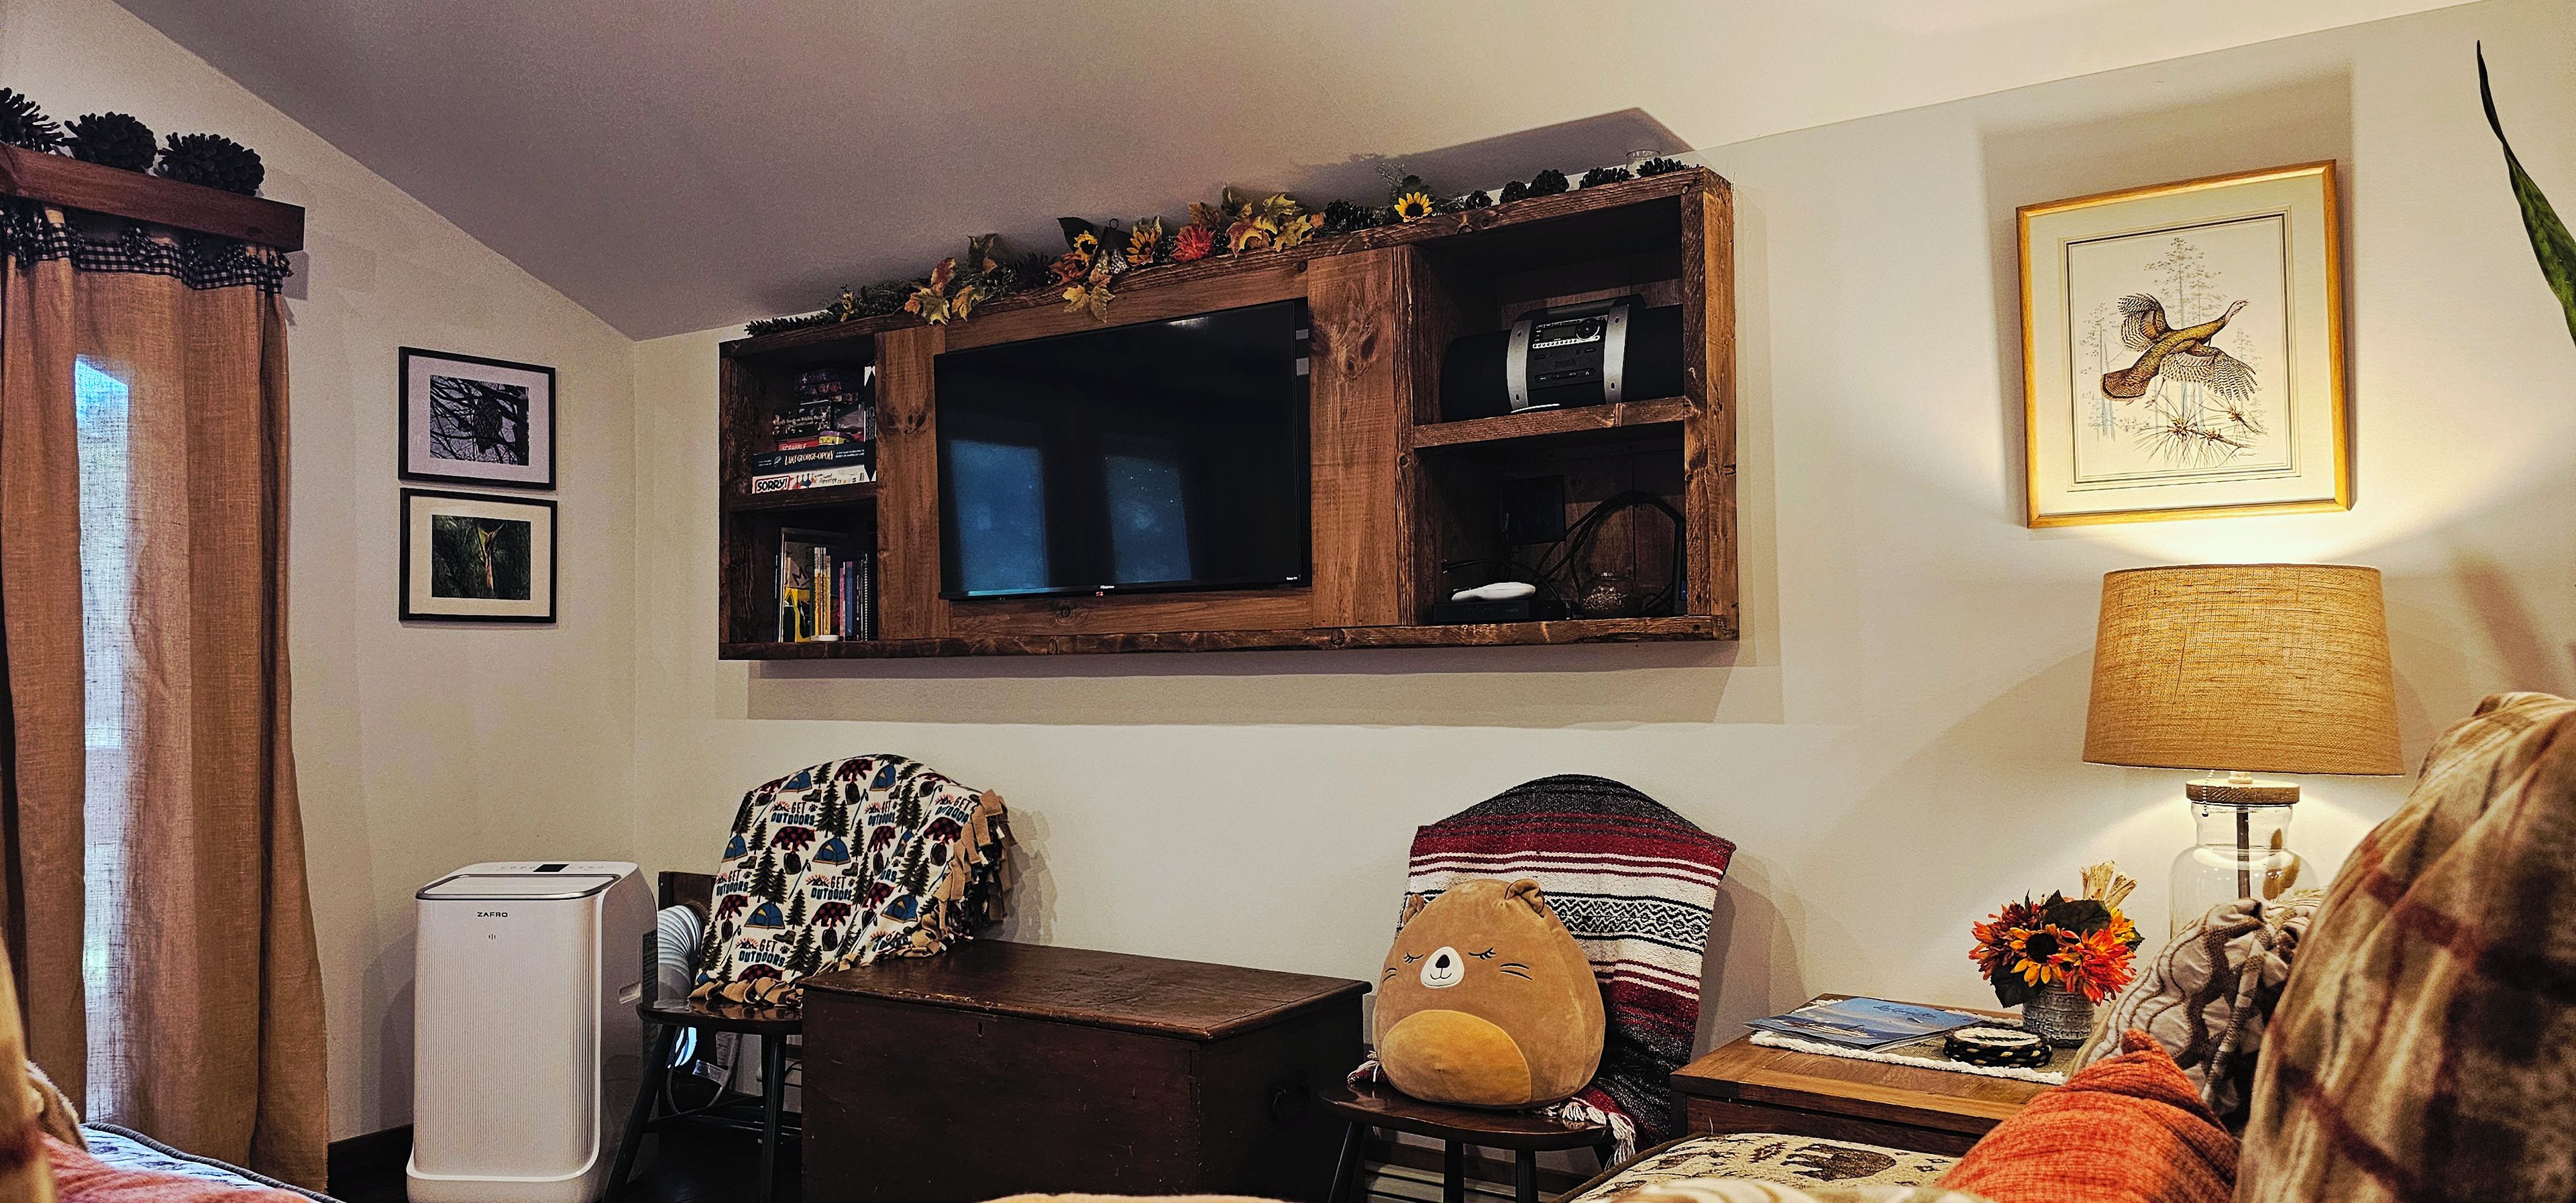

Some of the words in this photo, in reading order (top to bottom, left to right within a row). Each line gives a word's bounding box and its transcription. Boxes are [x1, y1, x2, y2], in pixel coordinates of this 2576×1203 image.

[757, 478, 788, 492] SORRY!
[792, 802, 806, 814] GET
[881, 800, 892, 813] GET
[953, 796, 972, 811] GET
[771, 812, 815, 826] OUTDOORS
[729, 870, 741, 882] GET
[830, 876, 846, 890] GET
[810, 887, 852, 900] OUTDOORS
[759, 939, 777, 953] GET
[739, 950, 785, 967] OUTDOORS
